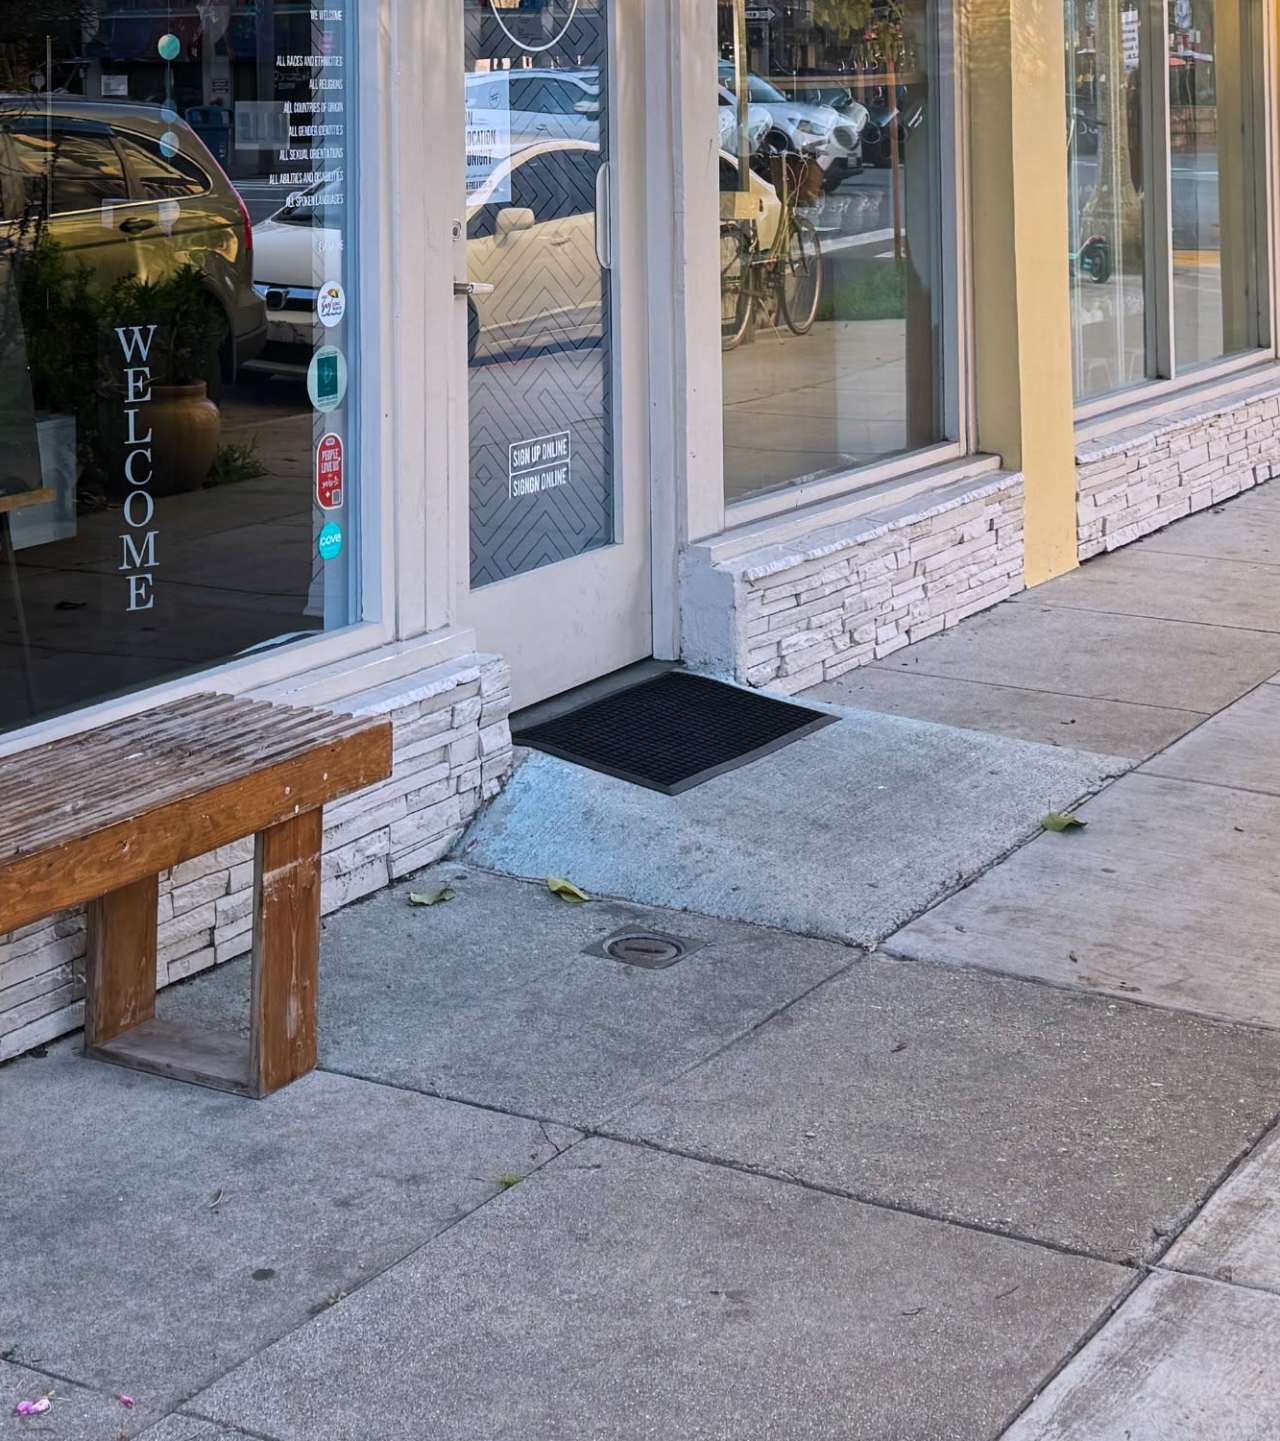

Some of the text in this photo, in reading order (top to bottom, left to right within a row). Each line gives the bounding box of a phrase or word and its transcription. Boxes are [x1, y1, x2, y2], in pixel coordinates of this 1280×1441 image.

[276, 55, 286, 66] ALL
[287, 55, 303, 66] RACES
[309, 78, 318, 89] ALL
[283, 101, 293, 113] ALL
[289, 125, 297, 136] ALL
[467, 129, 496, 146] OCATION
[279, 149, 288, 160] ALL
[467, 149, 492, 166] ONIGHT
[269, 173, 278, 185] ALL
[513, 439, 567, 467] SIGN UP ONLINE
[114, 324, 160, 612] WELCOME
[541, 467, 567, 490] ONLINE
